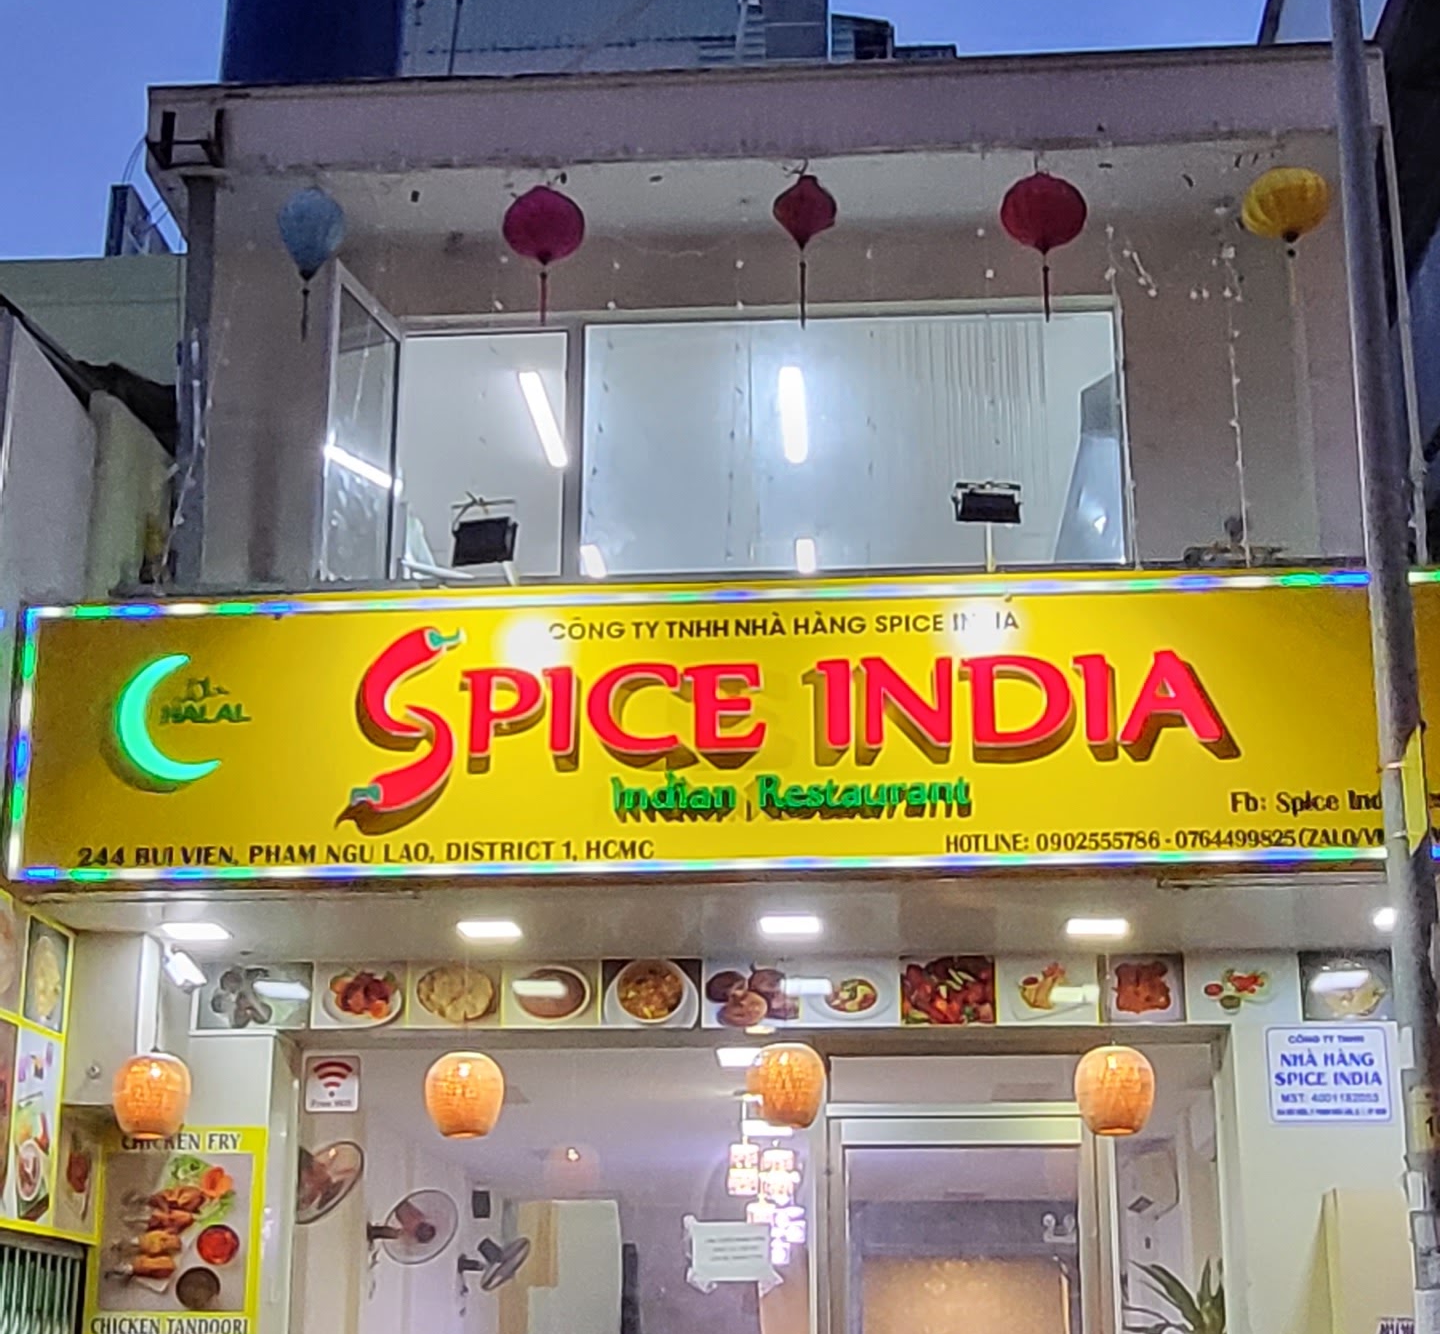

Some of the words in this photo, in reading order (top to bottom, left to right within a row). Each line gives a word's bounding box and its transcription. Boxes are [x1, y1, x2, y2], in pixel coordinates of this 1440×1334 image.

[549, 618, 625, 640] CÔNG
[632, 621, 659, 639] TY
[666, 620, 728, 638] TNHH
[734, 612, 785, 636] NHÀ
[794, 611, 865, 635] HÀNG
[875, 615, 943, 632] SPICE
[953, 611, 1018, 631] IIA
[350, 624, 768, 815] SPICE
[813, 650, 1223, 751] INDIA
[611, 771, 737, 810] Indian
[756, 775, 970, 809] Restaurant
[1230, 791, 1267, 813] Fb:
[78, 847, 125, 866] 244
[135, 847, 174, 865] BUI
[249, 844, 317, 864] PHAM
[326, 844, 374, 863] NGU
[383, 842, 435, 863] LAO,
[446, 840, 555, 861] DISTRICT
[562, 840, 578, 862] 1,
[585, 840, 655, 860] HCMC
[946, 833, 1029, 853] HOTLINE:
[1036, 830, 1160, 851] 0902555786
[1280, 1047, 1318, 1067] NHÀ
[1323, 1047, 1375, 1067] HÀNG
[1274, 1071, 1327, 1086] SPICE
[1333, 1070, 1383, 1086] INDIA
[208, 1133, 240, 1149] FRY
